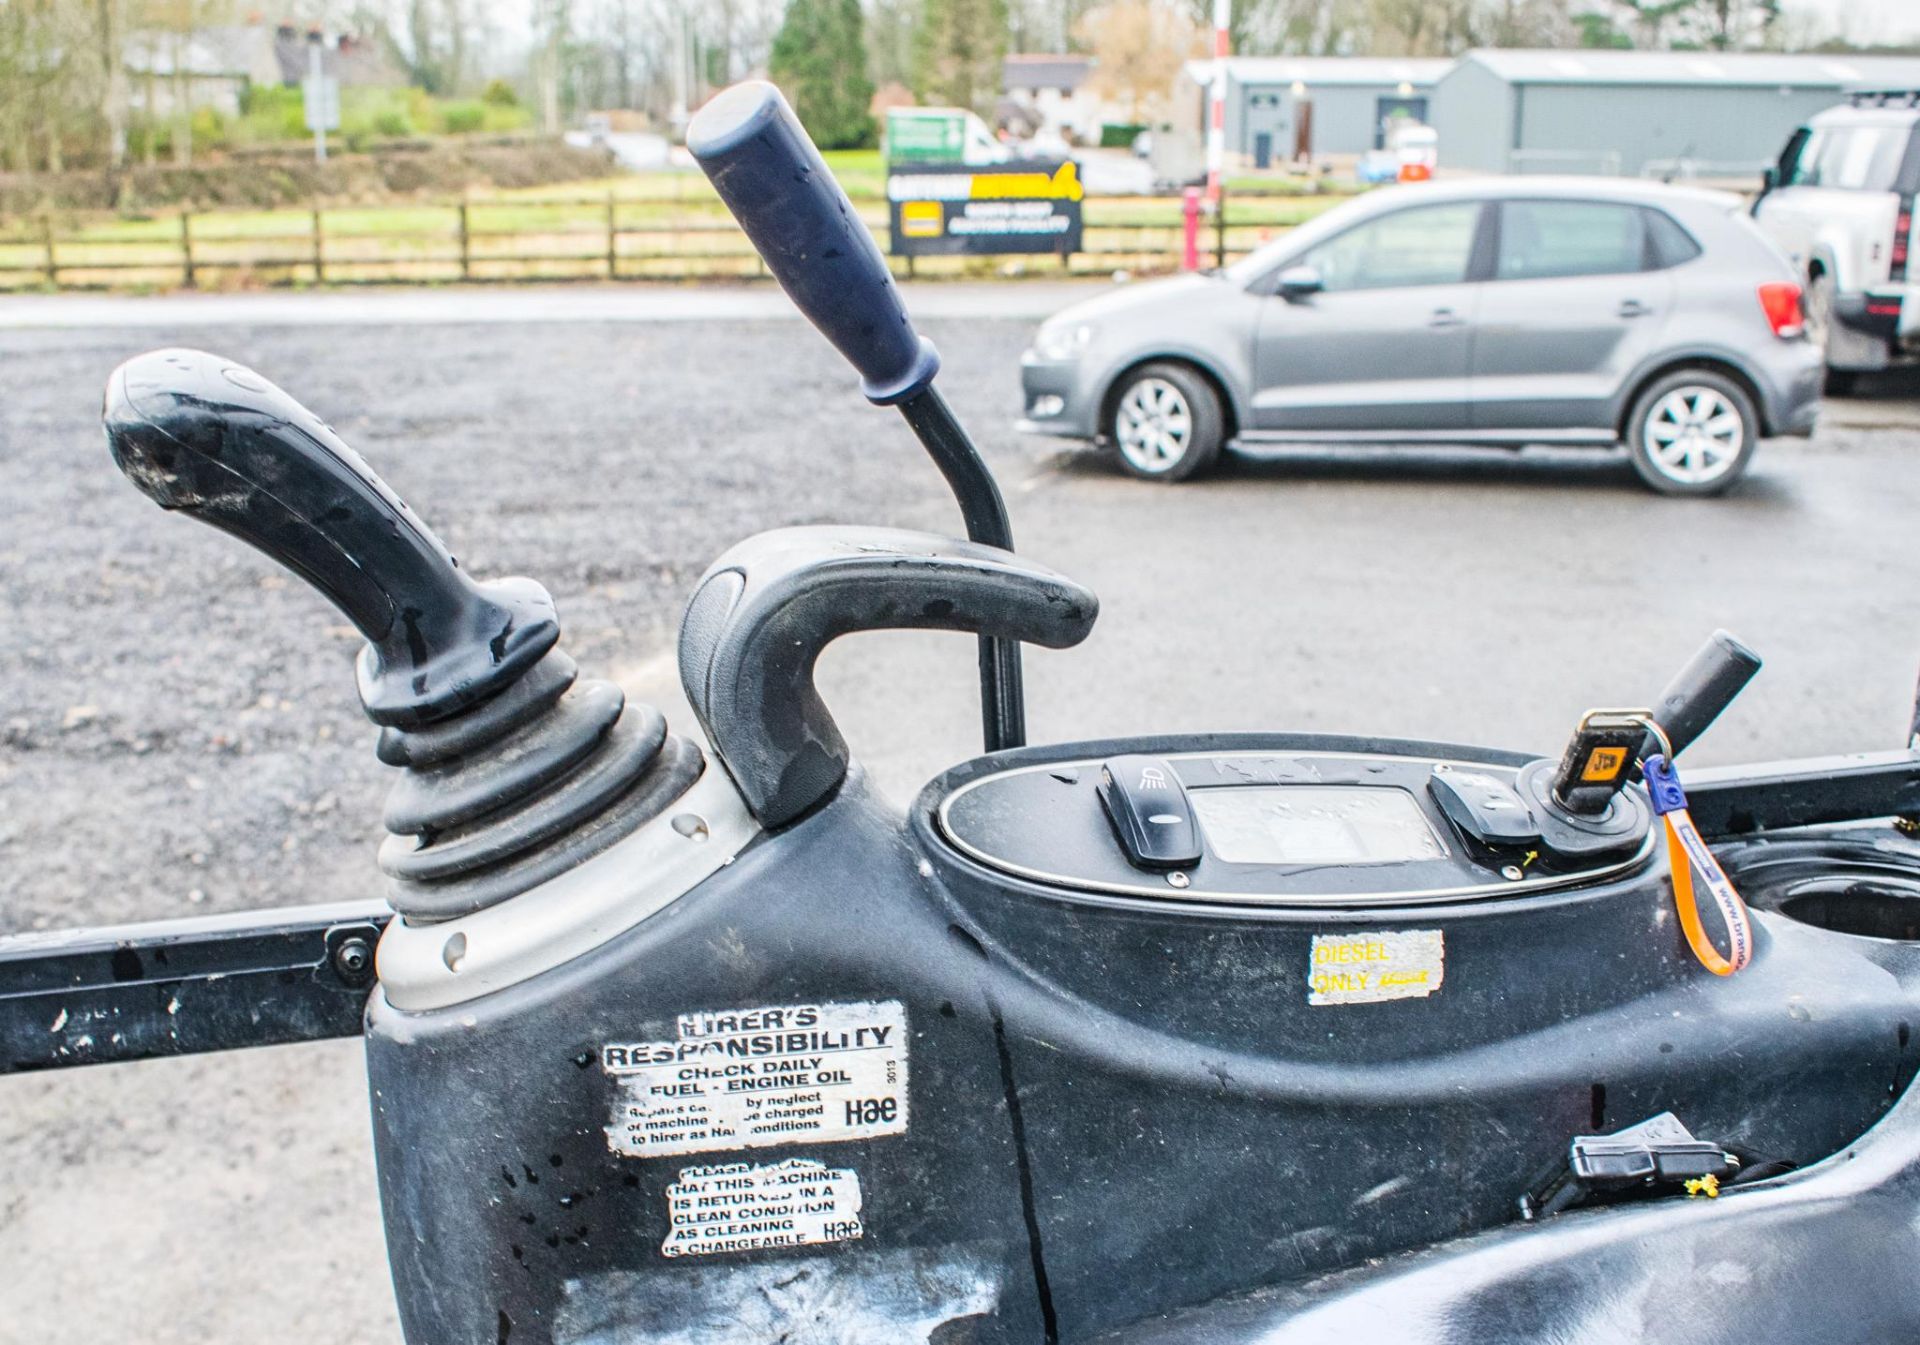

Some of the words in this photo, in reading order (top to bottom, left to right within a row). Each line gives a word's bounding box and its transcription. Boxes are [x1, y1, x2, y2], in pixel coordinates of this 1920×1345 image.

[1315, 943, 1390, 964] DIESEL
[1313, 972, 1370, 994] ONLY
[681, 1007, 818, 1036] HIRER'S
[763, 1057, 823, 1073] DAILY
[886, 1060, 896, 1084] 3013
[650, 1083, 705, 1097] FUEL
[728, 1074, 809, 1091] ENGINE
[816, 1070, 852, 1083] OIL
[747, 1097, 763, 1109] by
[767, 1092, 822, 1107] neglect
[645, 1116, 708, 1130] machine
[765, 1105, 824, 1120] charged
[631, 1134, 646, 1145] to
[650, 1131, 685, 1144] hirer
[690, 1129, 706, 1140] as
[667, 1180, 708, 1195] HAT
[714, 1178, 755, 1190] THIS
[763, 1170, 843, 1188] ACHINE
[674, 1198, 692, 1210] IS
[799, 1187, 817, 1198] IN
[822, 1186, 835, 1197] A
[673, 1210, 732, 1225] CLEAN
[675, 1229, 699, 1241] AS
[705, 1219, 795, 1237] CLEANING
[687, 1233, 807, 1255] CHARGEABLE
